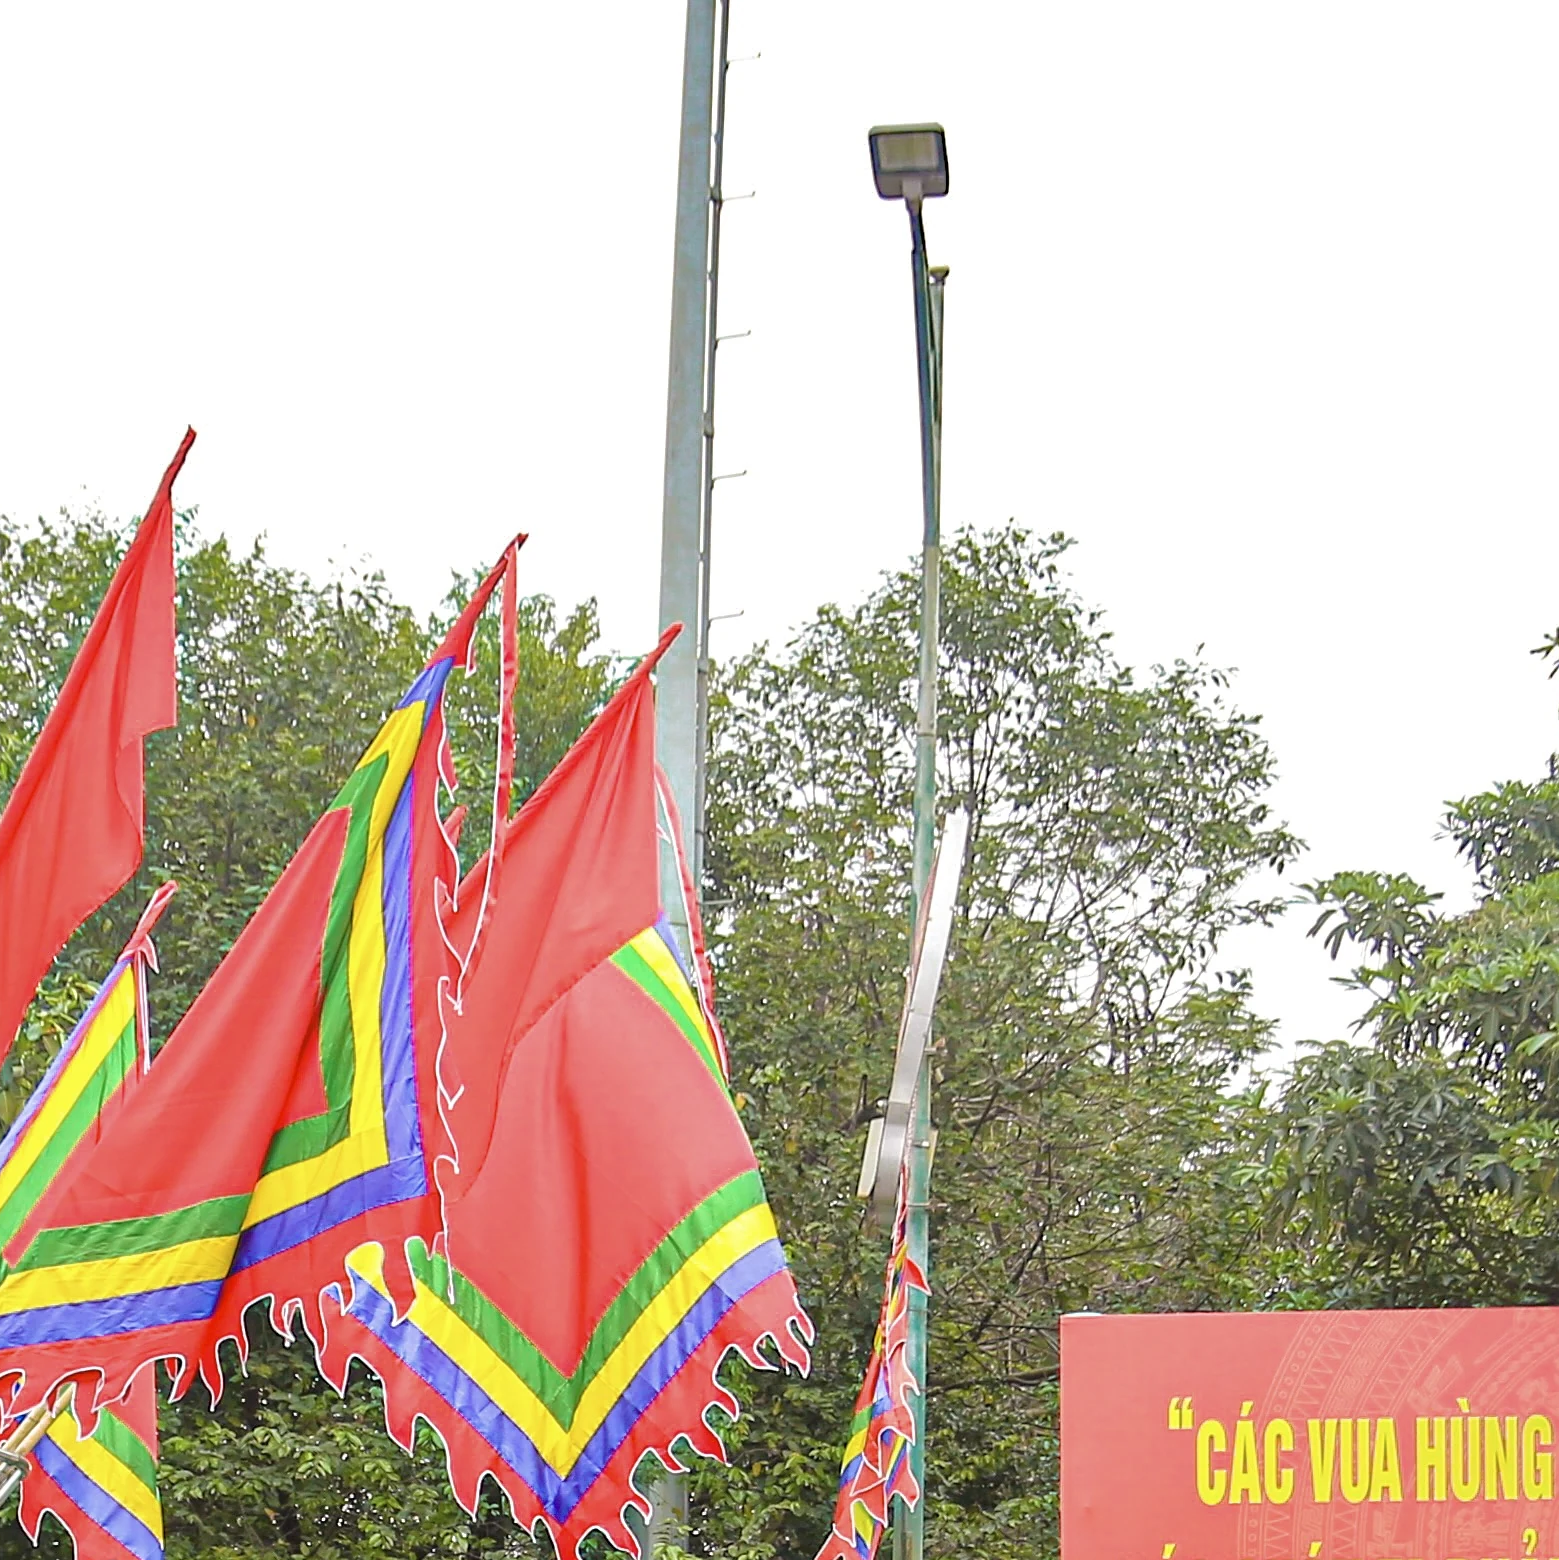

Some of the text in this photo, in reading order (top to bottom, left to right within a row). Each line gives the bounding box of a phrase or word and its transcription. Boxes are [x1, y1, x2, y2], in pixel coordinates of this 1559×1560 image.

[1168, 1397, 1296, 1505] “CÁC
[1307, 1416, 1403, 1504] VUA
[1415, 1396, 1556, 1502] HÙNG
